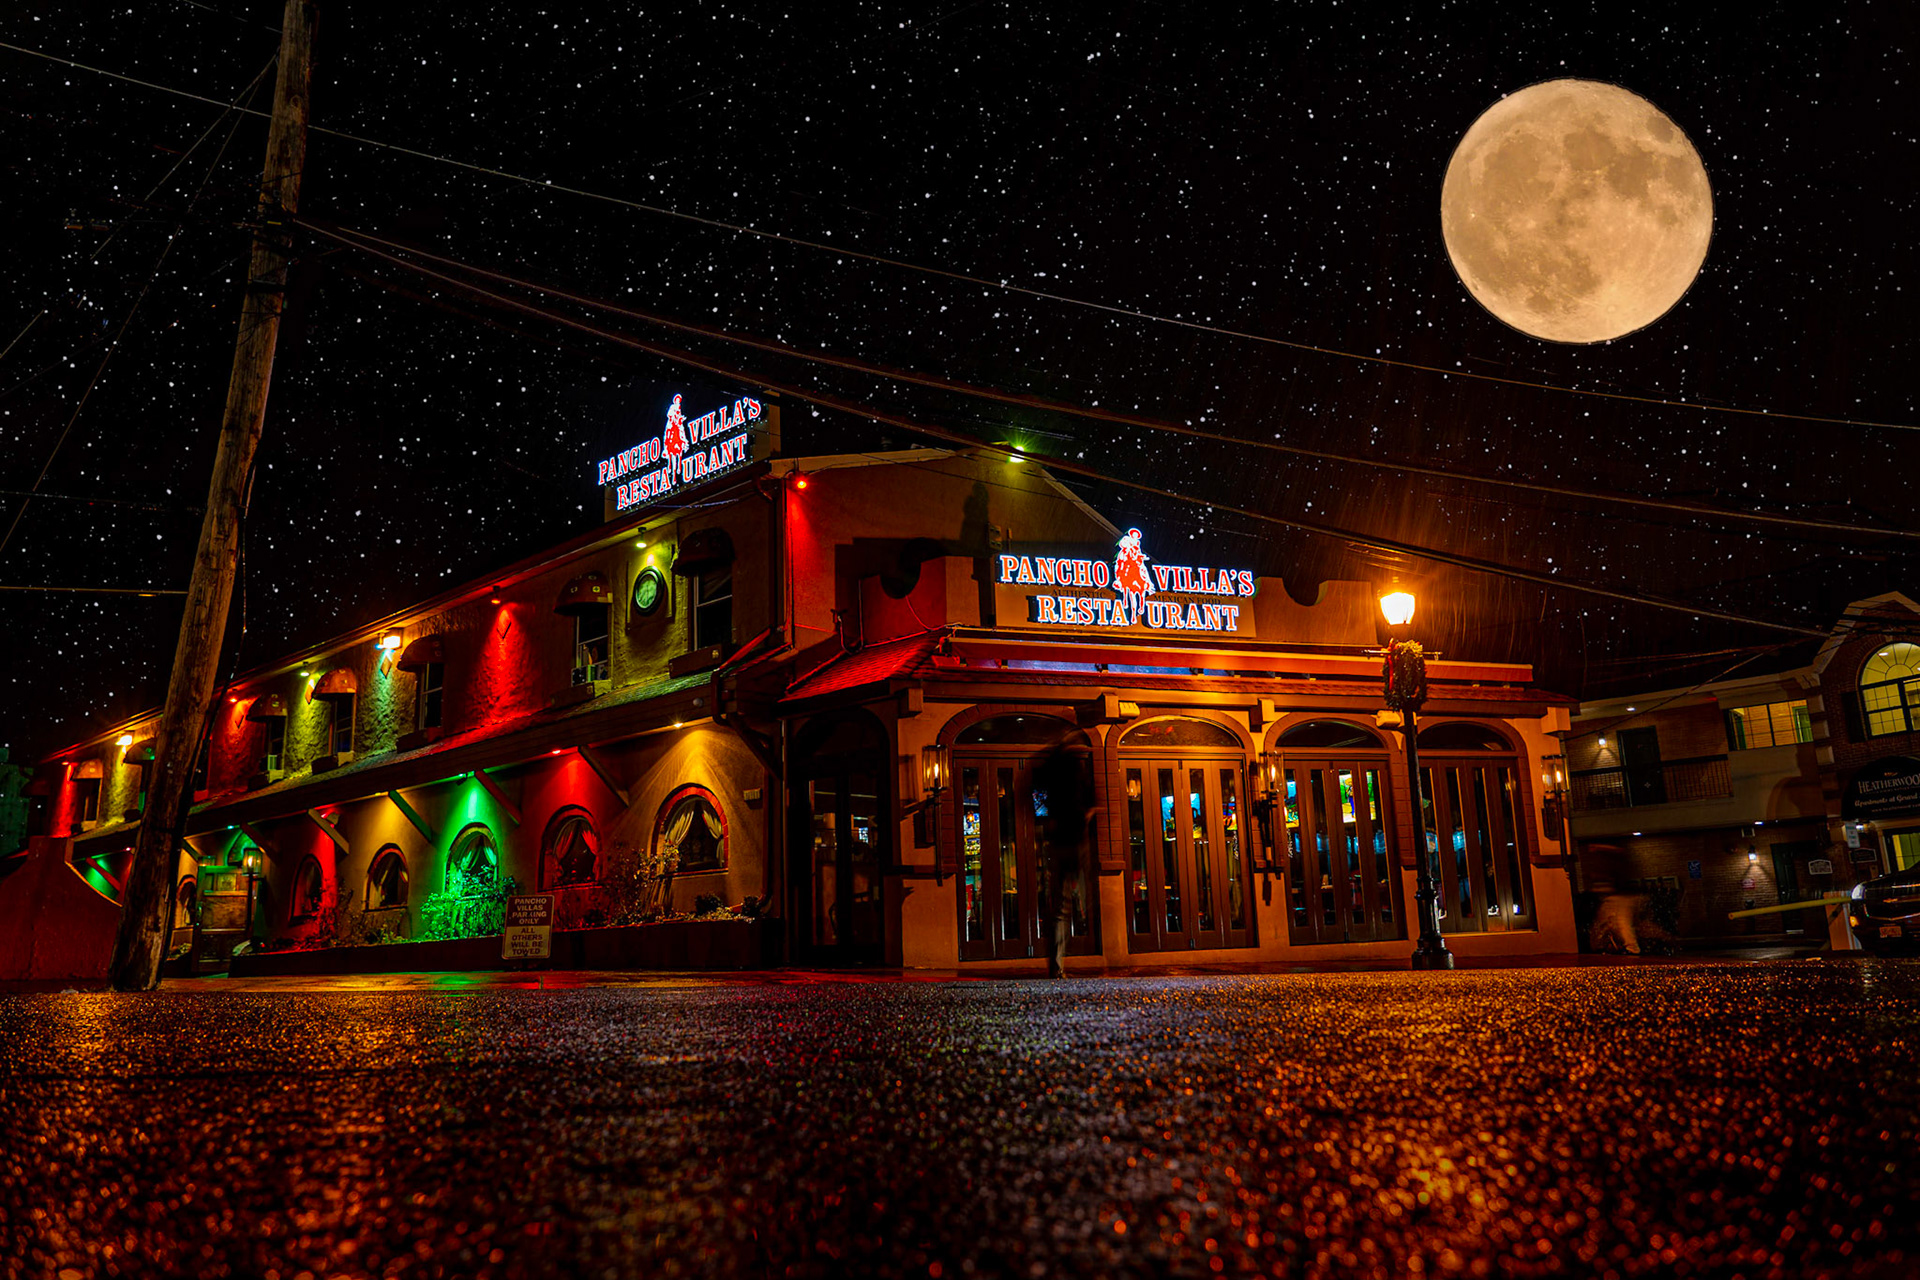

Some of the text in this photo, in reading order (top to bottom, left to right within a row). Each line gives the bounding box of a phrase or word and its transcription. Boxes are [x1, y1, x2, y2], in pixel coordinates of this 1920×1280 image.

[598, 397, 761, 485] PANCHO VILLA'S
[1000, 555, 1255, 597] PANCHO VILLA'S
[1053, 589, 1221, 605] AUTHENTIC MEXICAN FOOD
[1857, 773, 1920, 794] HEATHERWOO
